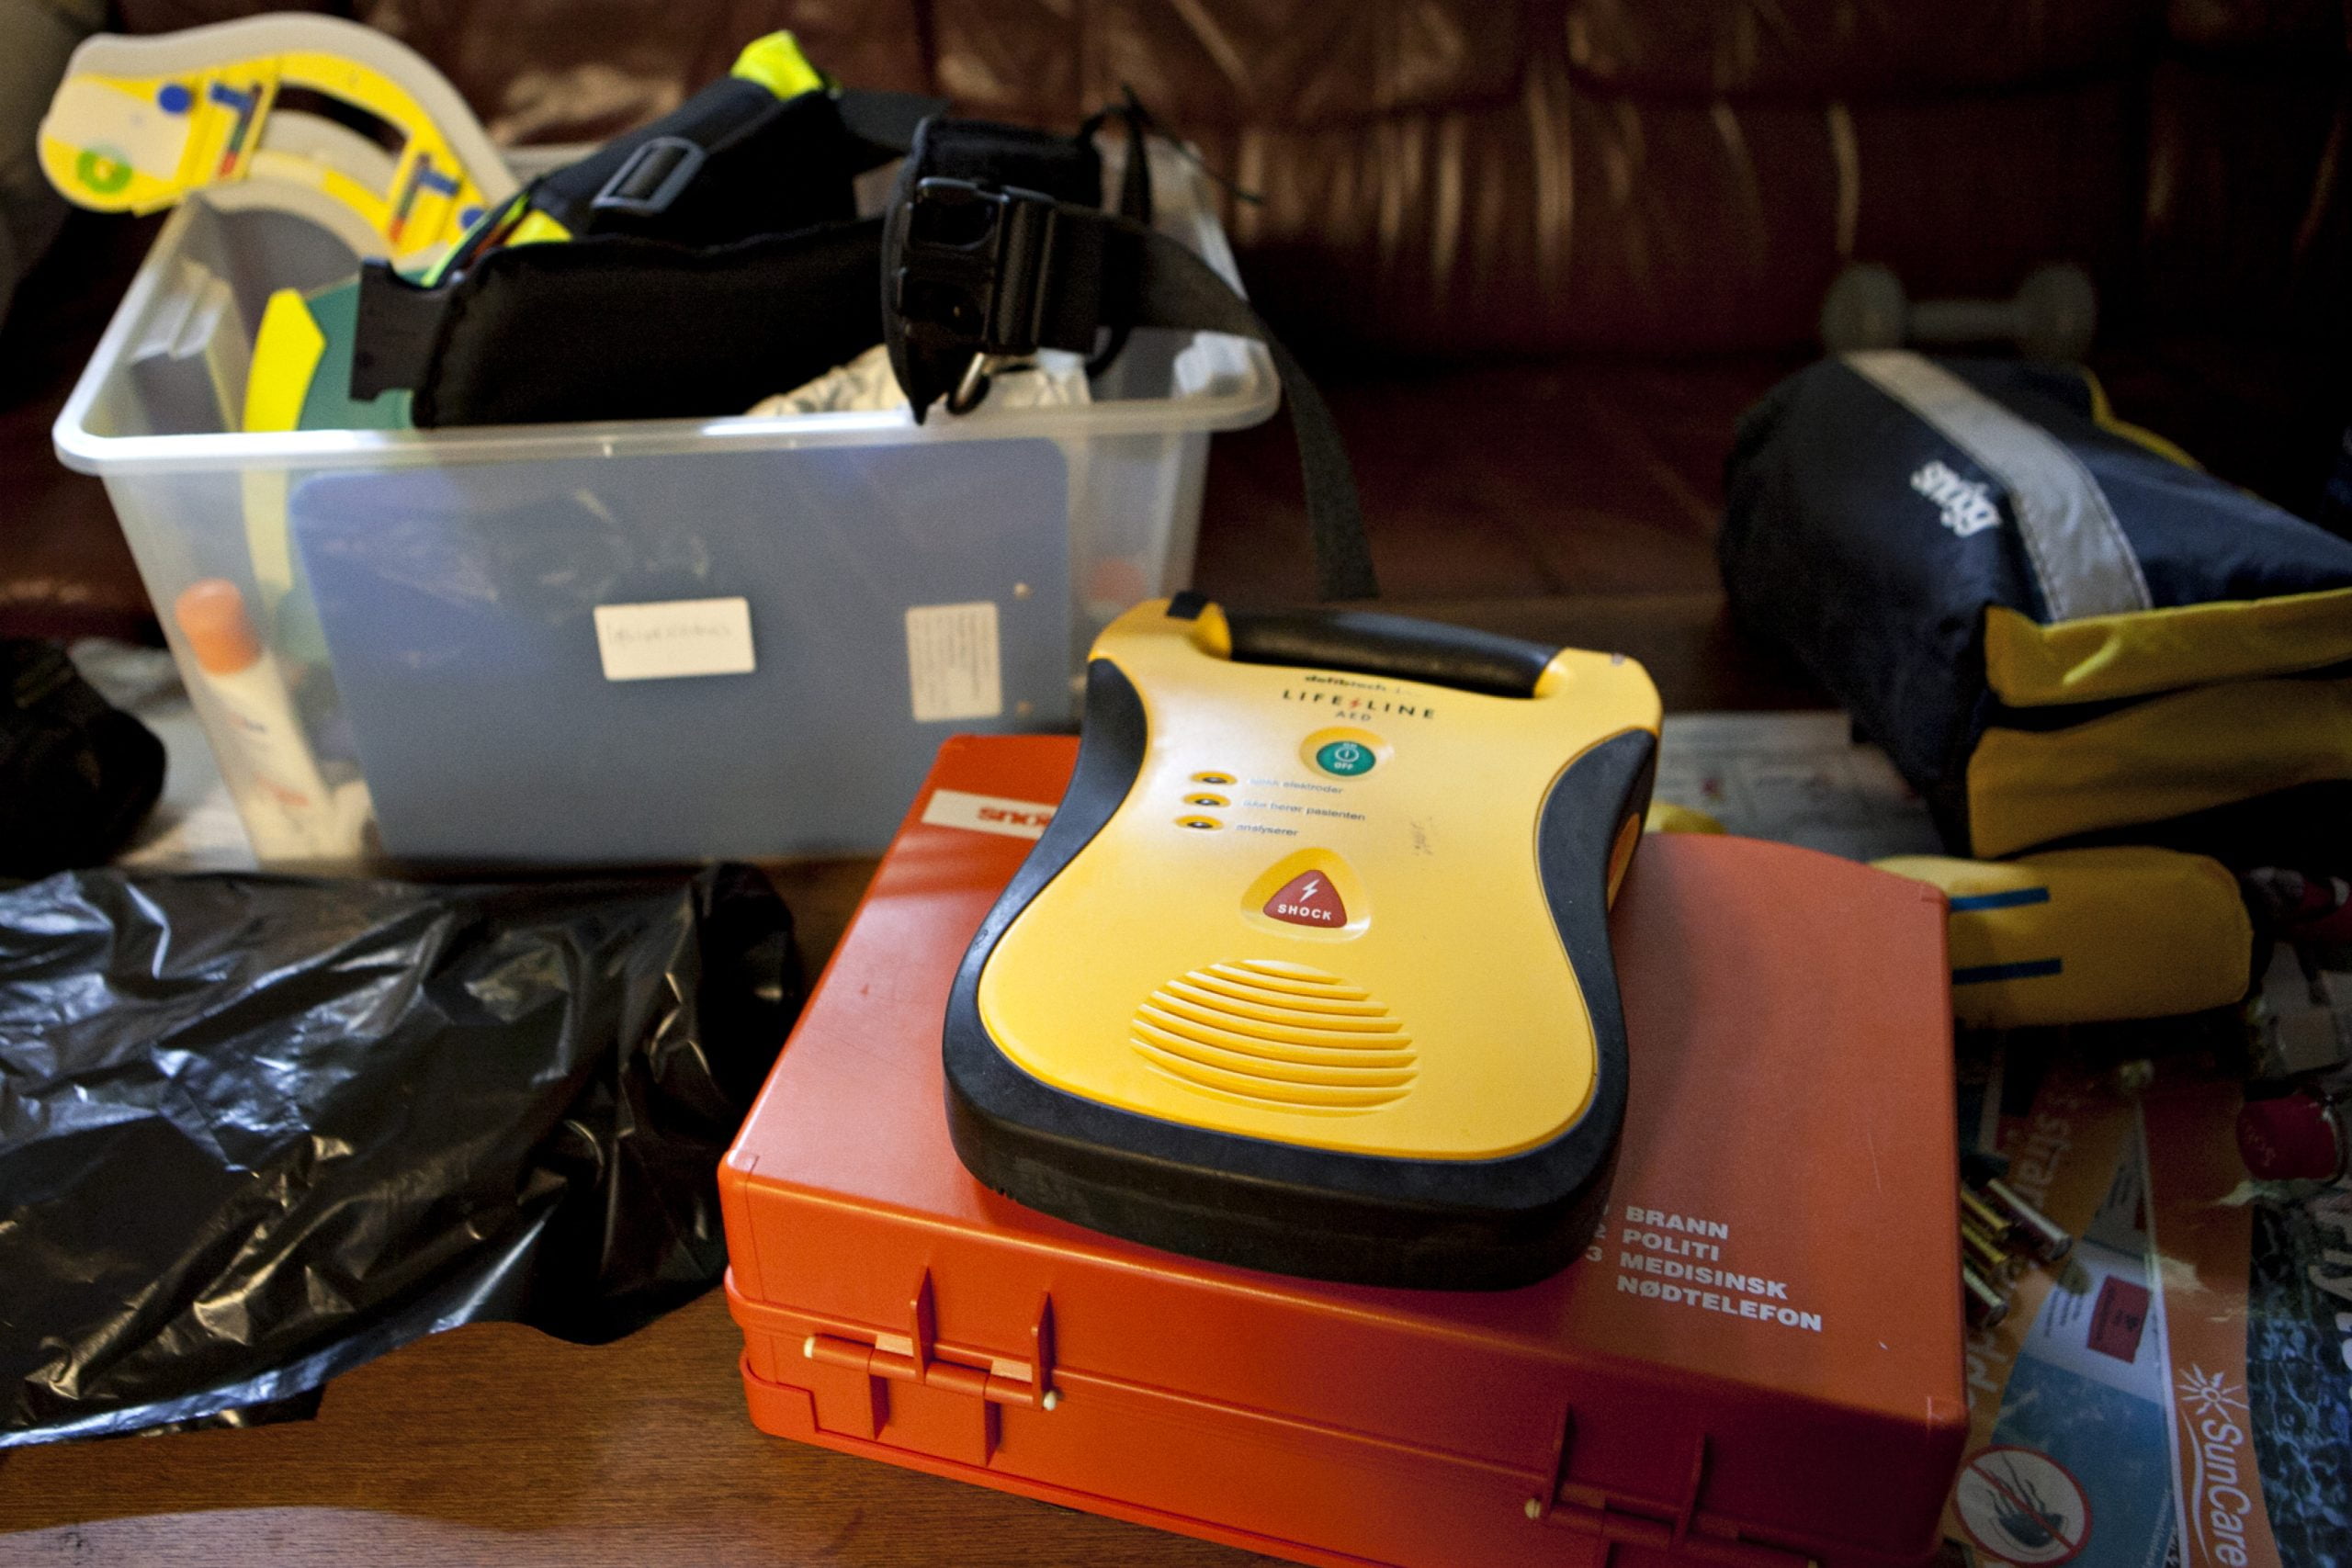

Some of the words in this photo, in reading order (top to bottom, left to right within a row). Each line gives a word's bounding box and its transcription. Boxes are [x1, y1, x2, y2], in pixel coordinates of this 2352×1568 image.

[1335, 710, 1372, 722] AED
[1334, 761, 1353, 770] OFF
[1283, 781, 1343, 795] elektroder
[1306, 807, 1366, 821] pasienten
[1236, 823, 1299, 838] analyserer
[1277, 904, 1332, 921] SHOCK
[1625, 1205, 1728, 1240] BRANN
[1623, 1228, 1719, 1261] POLITI
[1620, 1251, 1788, 1300] MEDISINSK
[1617, 1274, 1822, 1332] NØDTELEFON
[2201, 1419, 2251, 1567] SunCare
